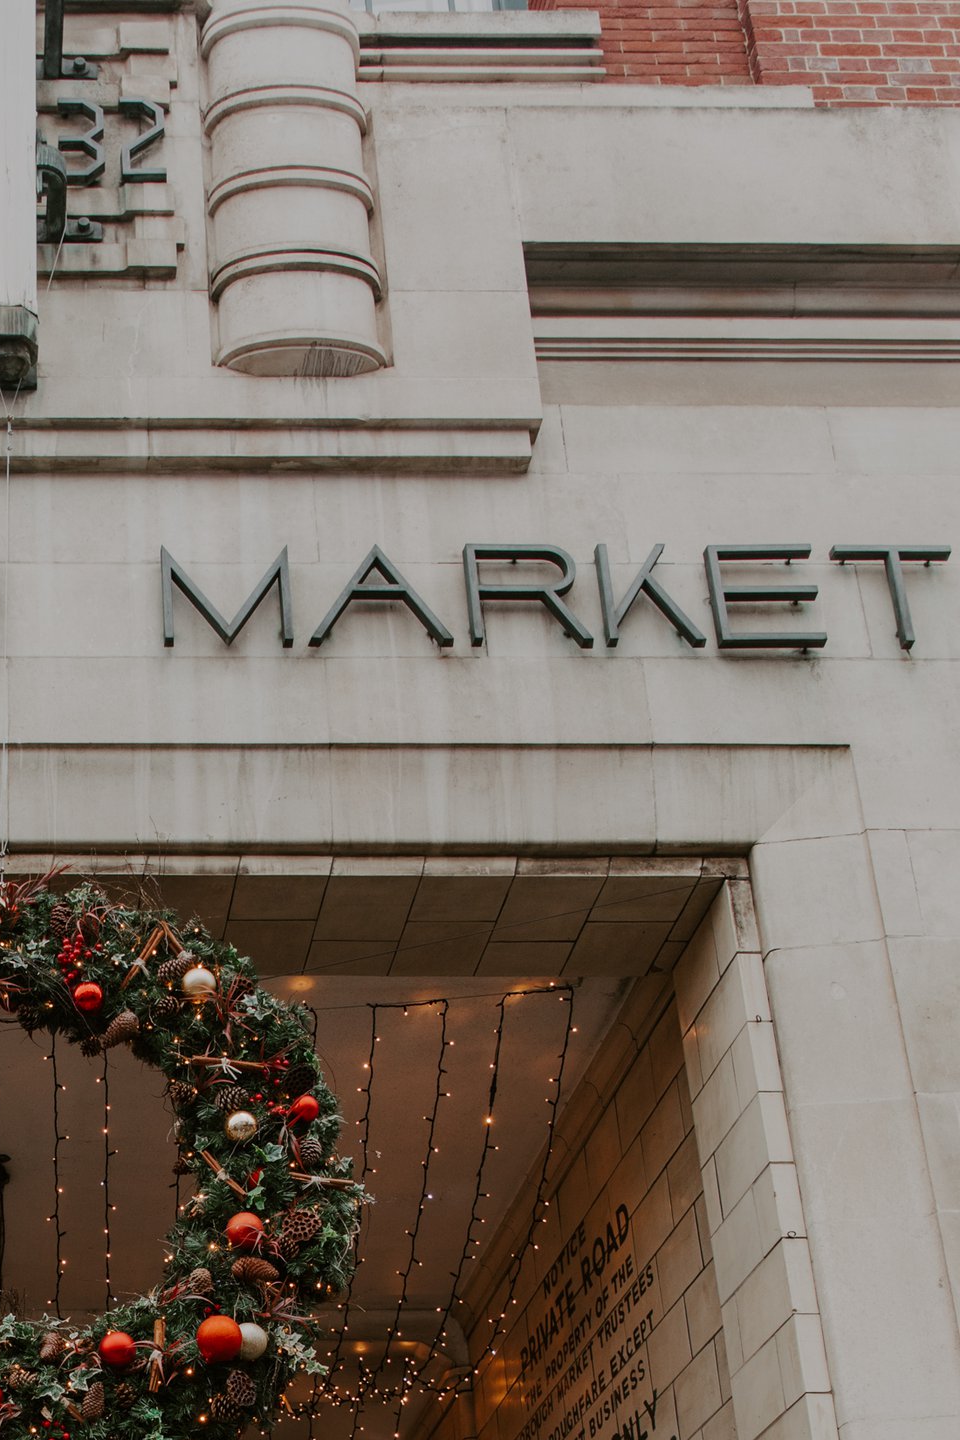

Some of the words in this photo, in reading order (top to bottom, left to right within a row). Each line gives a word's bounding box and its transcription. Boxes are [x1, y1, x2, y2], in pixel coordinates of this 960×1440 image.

[160, 543, 952, 650] MARKET
[519, 1280, 576, 1382] PRIVATE
[580, 1203, 629, 1296] ROAD
[542, 1220, 586, 1299] NOTICE
[525, 1385, 543, 1412] THE
[545, 1308, 592, 1384] PROPERTY
[595, 1288, 609, 1318] OF
[611, 1254, 634, 1294] THE
[557, 1341, 595, 1402] MARKET
[597, 1264, 654, 1348] TRUSTEES
[610, 1309, 654, 1381] EXCEPT
[589, 1359, 646, 1438] BUSINESS
